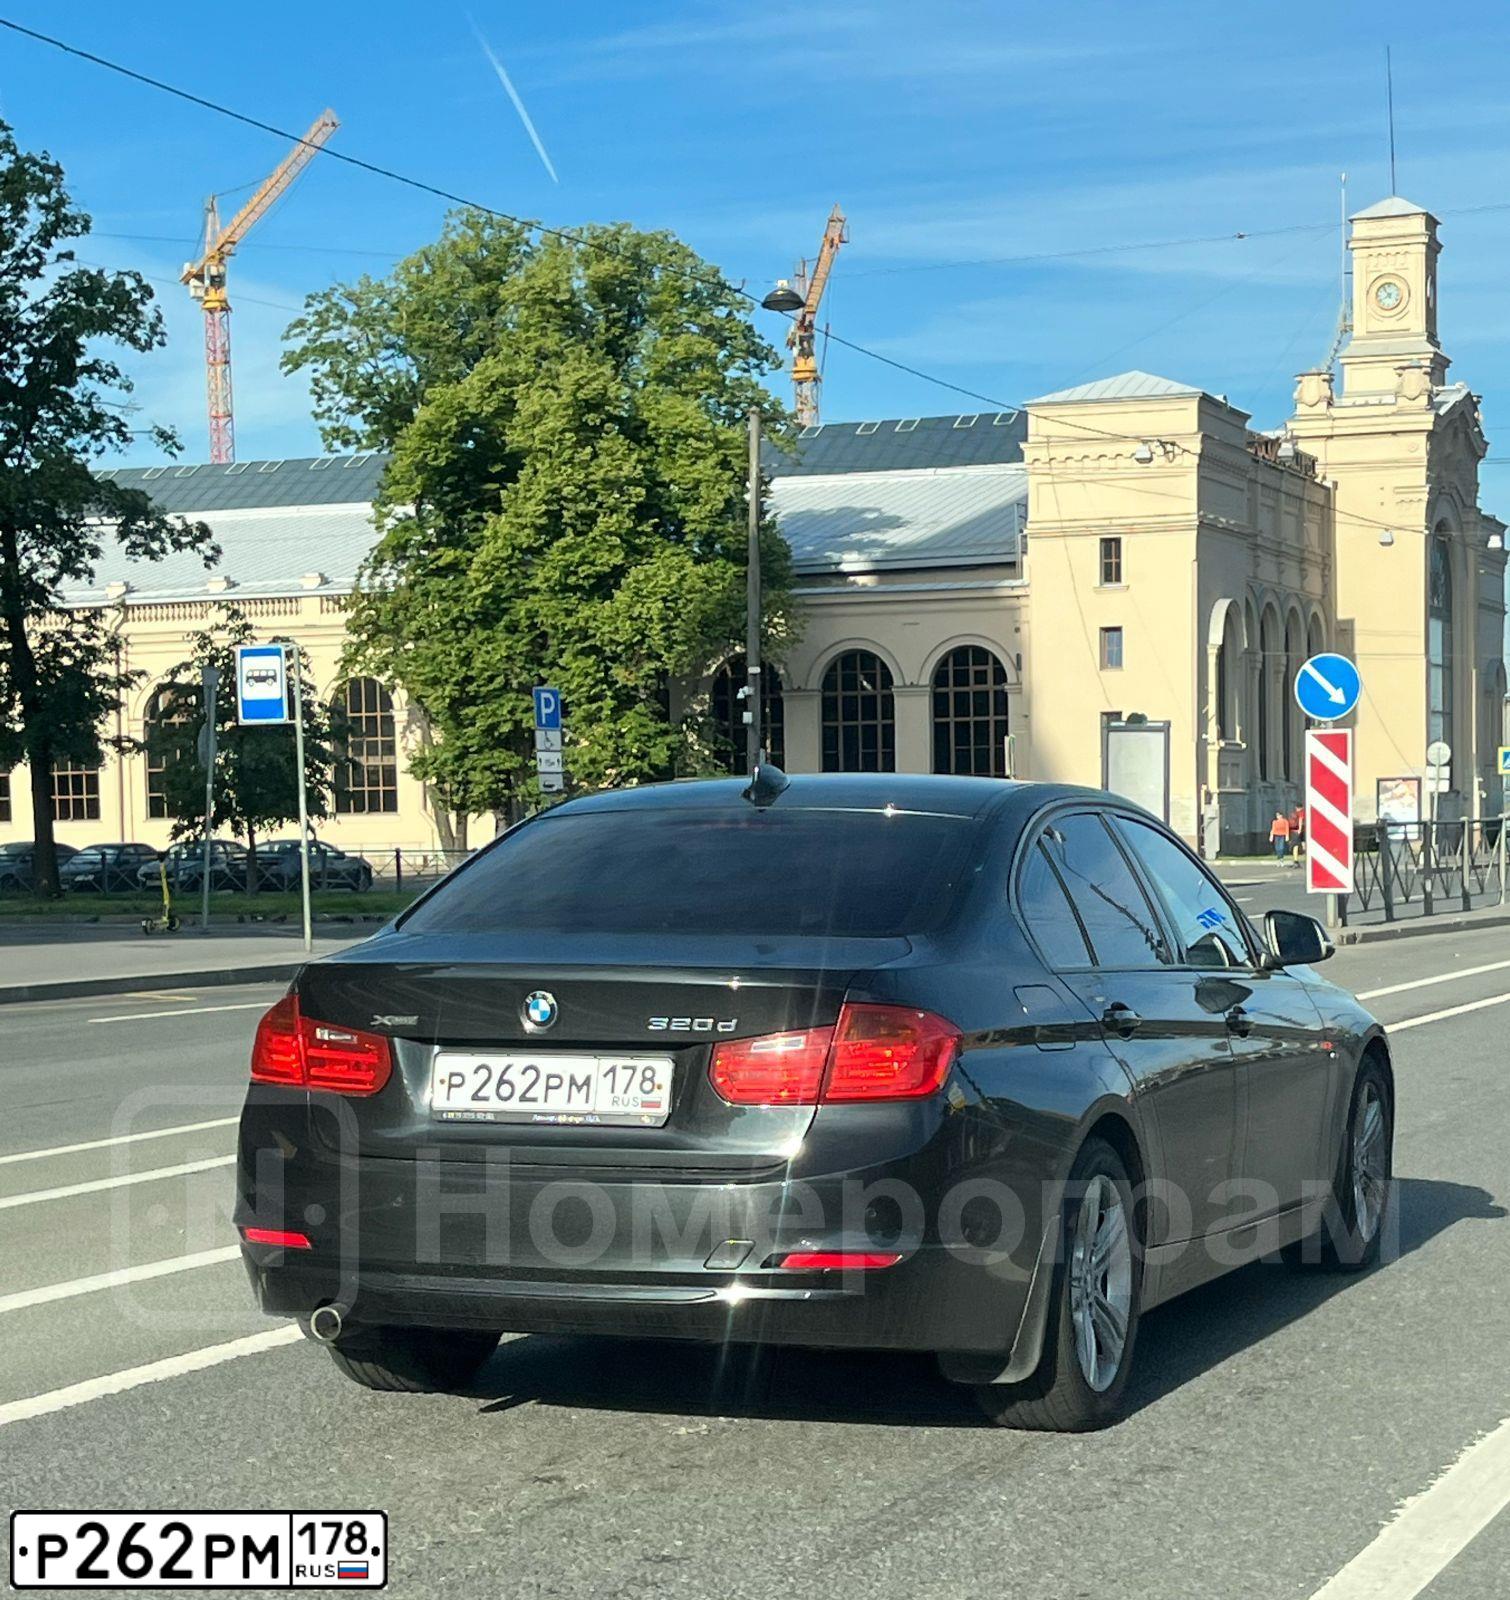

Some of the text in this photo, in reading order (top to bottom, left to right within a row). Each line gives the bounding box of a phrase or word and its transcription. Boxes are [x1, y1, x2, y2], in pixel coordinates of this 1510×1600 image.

[541, 692, 555, 724] P
[647, 1017, 738, 1032] 320d
[603, 1065, 656, 1094] 178
[611, 1096, 640, 1106] RUS
